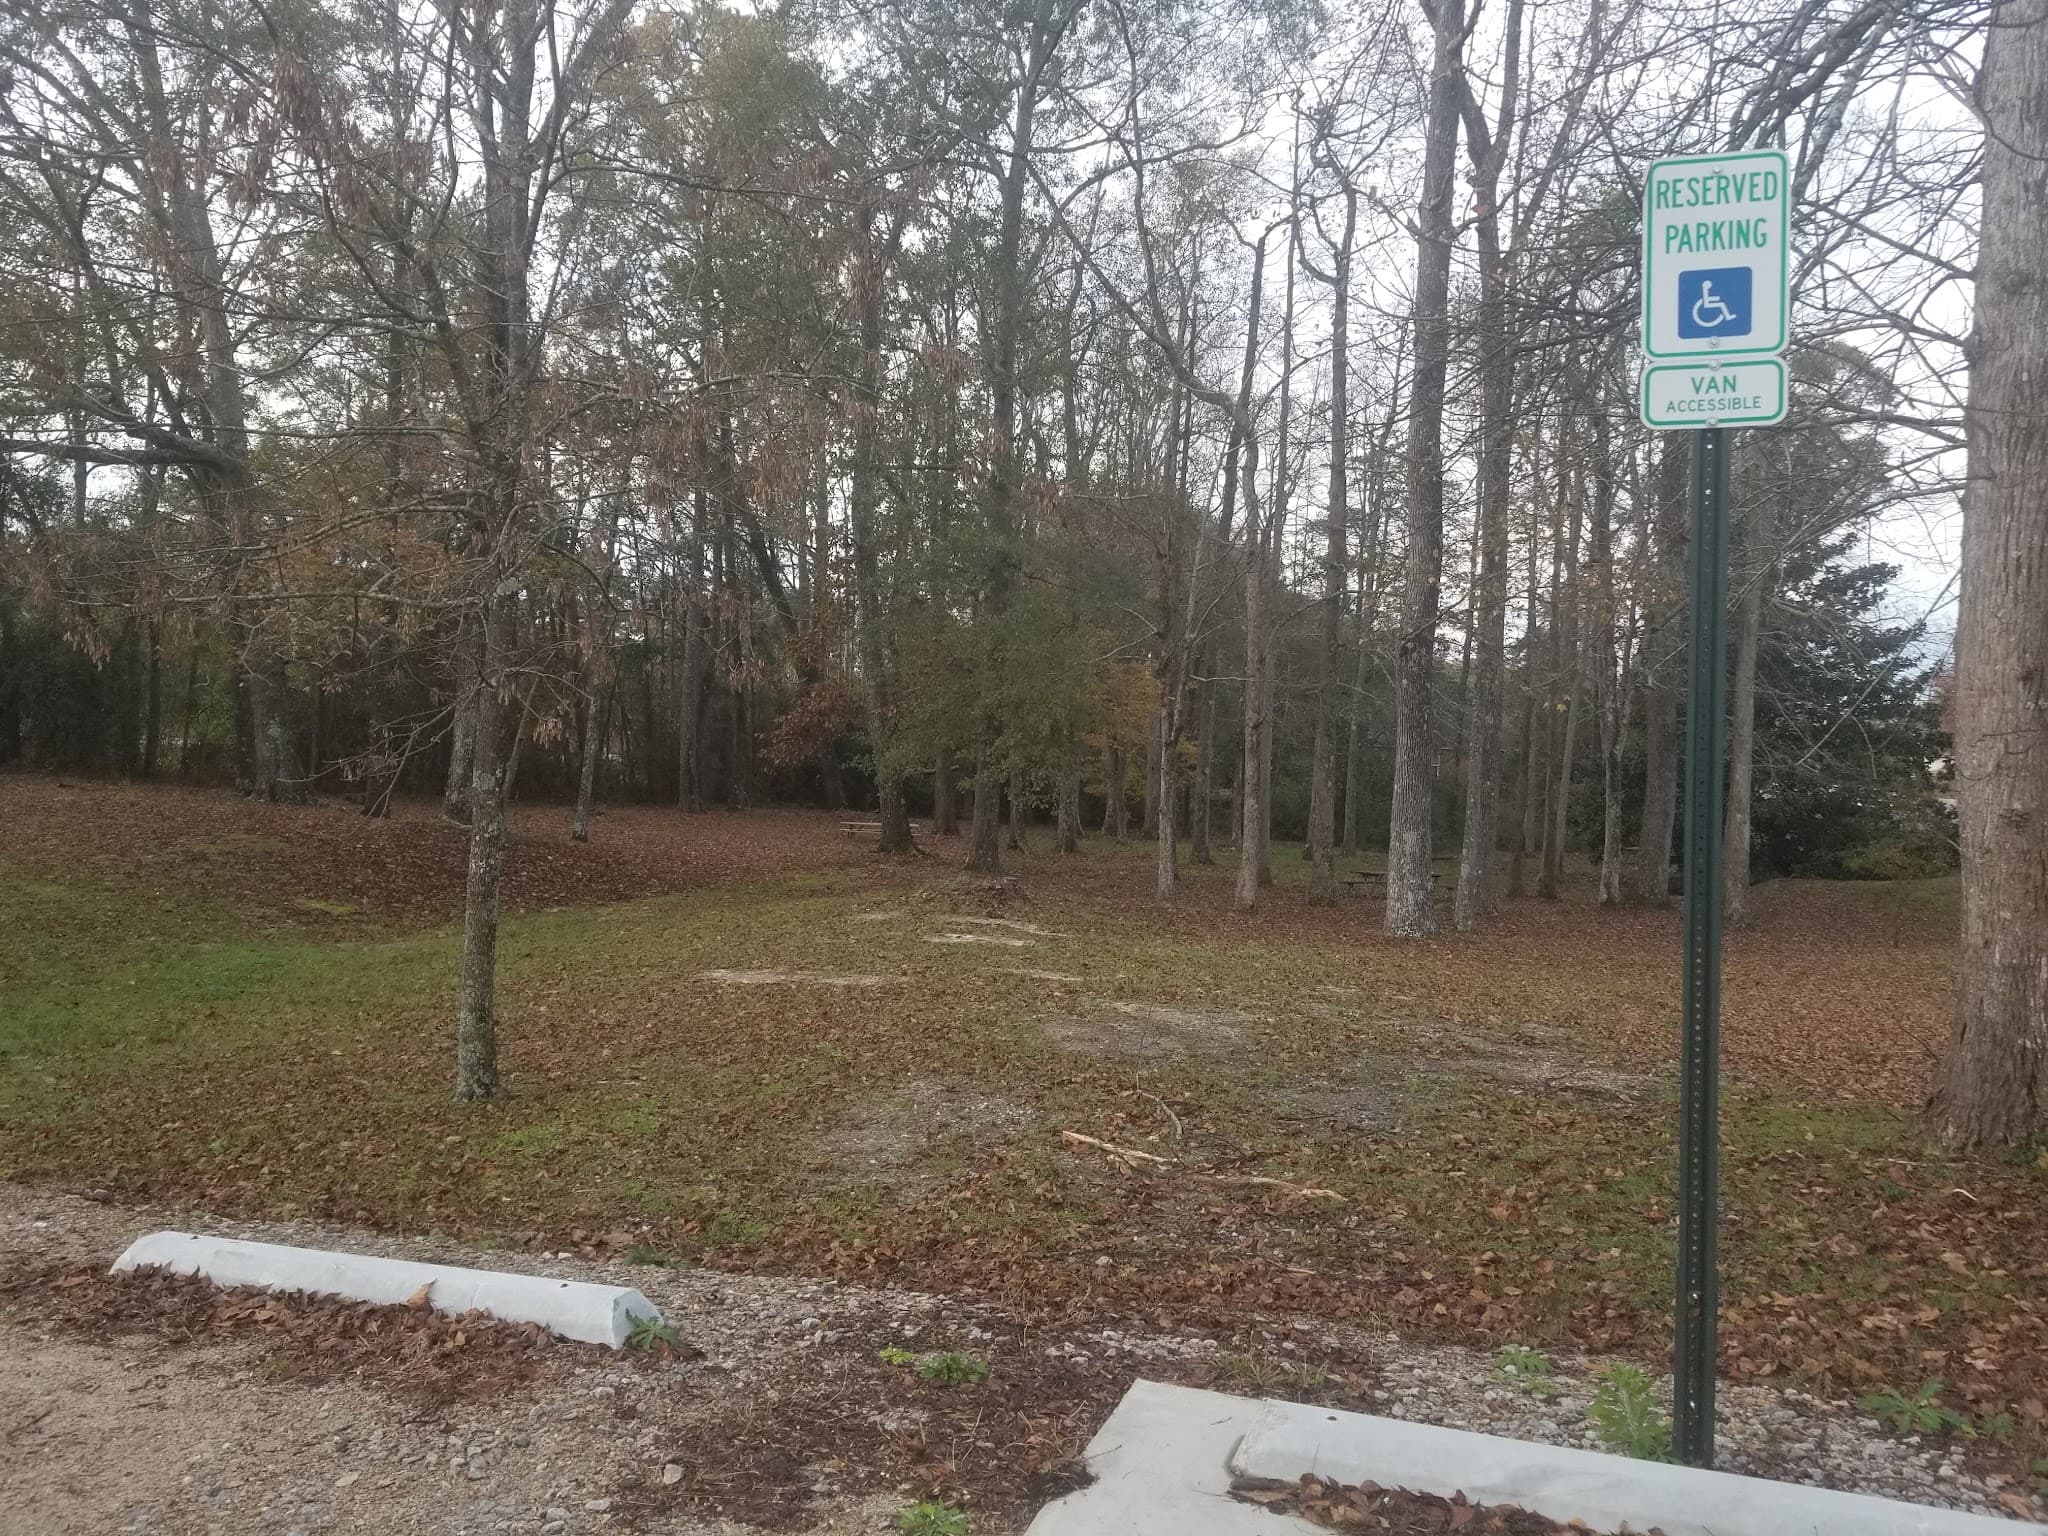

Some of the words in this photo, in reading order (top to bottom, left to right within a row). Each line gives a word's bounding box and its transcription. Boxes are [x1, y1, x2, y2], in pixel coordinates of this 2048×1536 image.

[1656, 171, 1778, 209] RESERVED
[1665, 217, 1768, 254] PARKING
[1691, 375, 1737, 395] VAN
[1666, 396, 1762, 413] ACCESSIBLE
